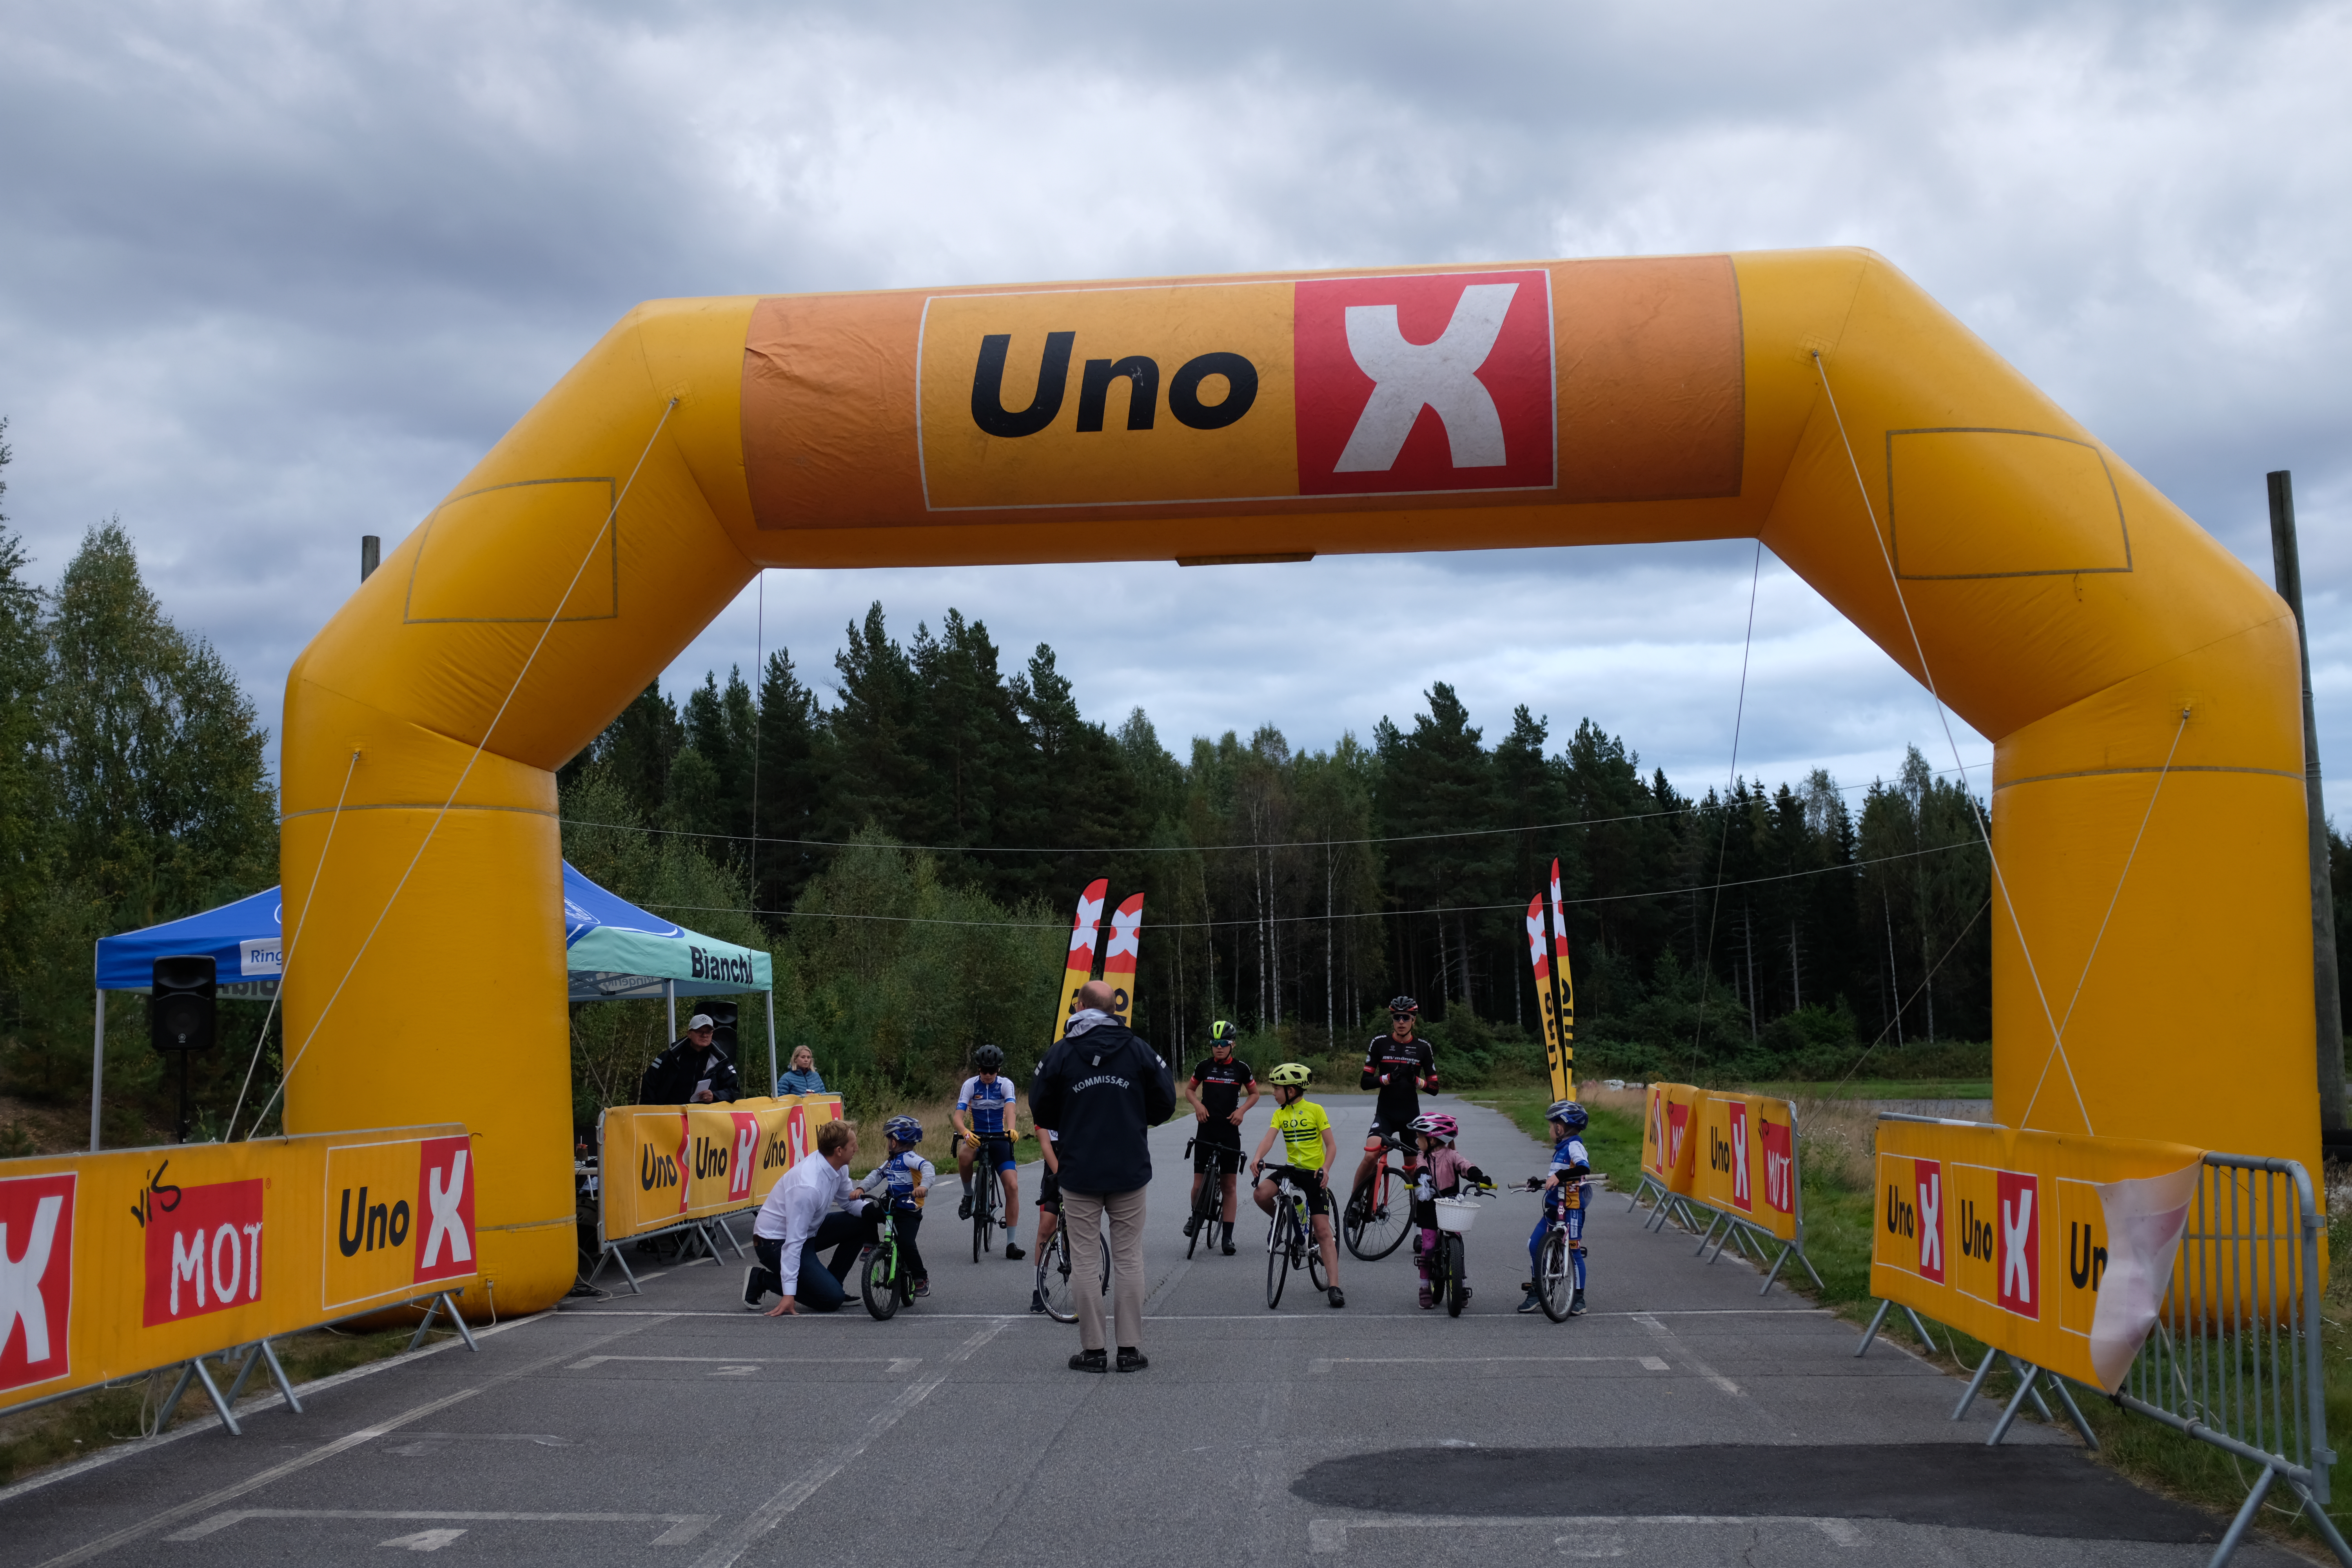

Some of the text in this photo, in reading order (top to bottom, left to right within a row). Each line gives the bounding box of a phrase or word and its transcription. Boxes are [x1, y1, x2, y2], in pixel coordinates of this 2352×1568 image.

[971, 282, 1519, 473] Uno X
[689, 945, 753, 984] Bianchi
[1072, 1075, 1130, 1093] KOMMISSÆR
[1283, 1119, 1308, 1128] BOC
[1671, 1125, 1684, 1166] MO
[641, 1143, 678, 1191] Uno
[696, 1137, 727, 1180] Uno
[763, 1131, 786, 1169] Uno
[1711, 1126, 1730, 1173] Uno
[1768, 1149, 1791, 1211] MOT
[339, 1186, 410, 1257] Uno
[1887, 1184, 1914, 1239] Uno
[1961, 1199, 1993, 1263] Uno
[170, 1222, 263, 1316] MOT
[2070, 1221, 2108, 1292] Un
